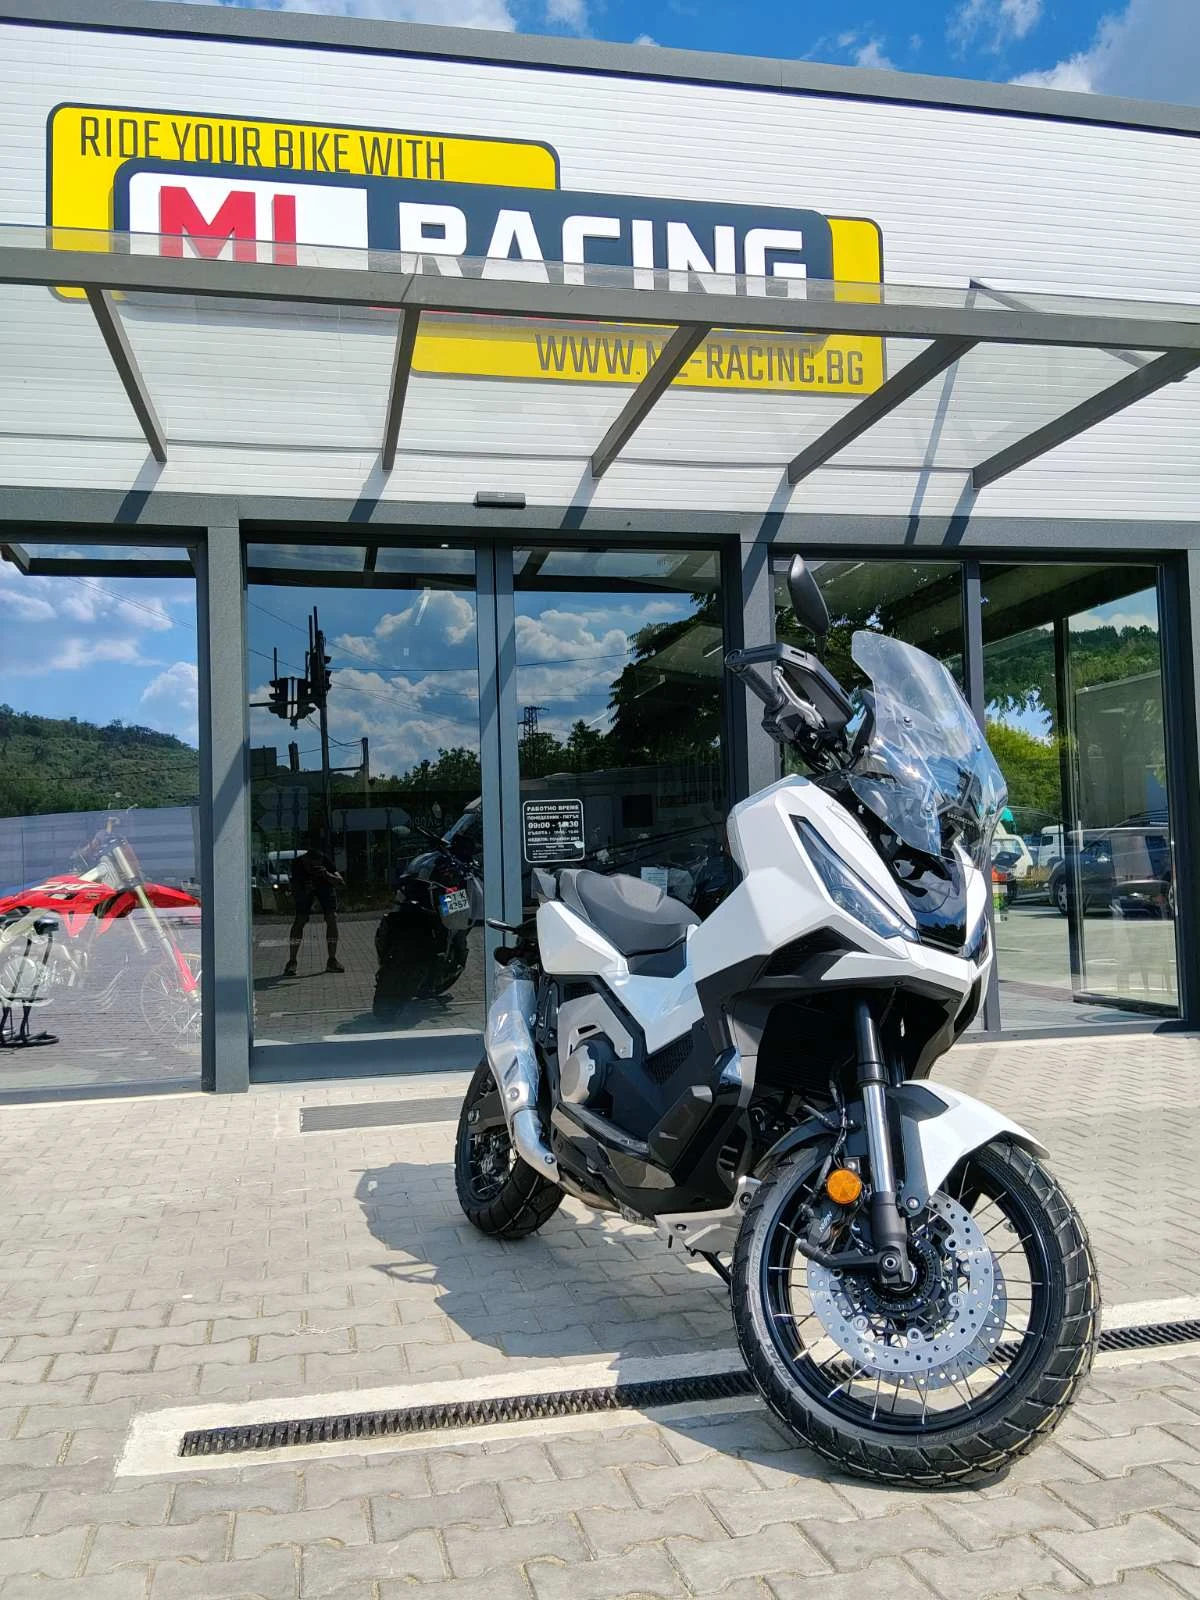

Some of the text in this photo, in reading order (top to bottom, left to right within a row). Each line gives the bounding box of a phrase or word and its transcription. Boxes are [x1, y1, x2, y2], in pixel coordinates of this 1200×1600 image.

[80, 116, 445, 180] RIDE YOUR BIKE WITH
[399, 202, 807, 299] RACING
[534, 333, 865, 386] WWW.M-RACING.BG
